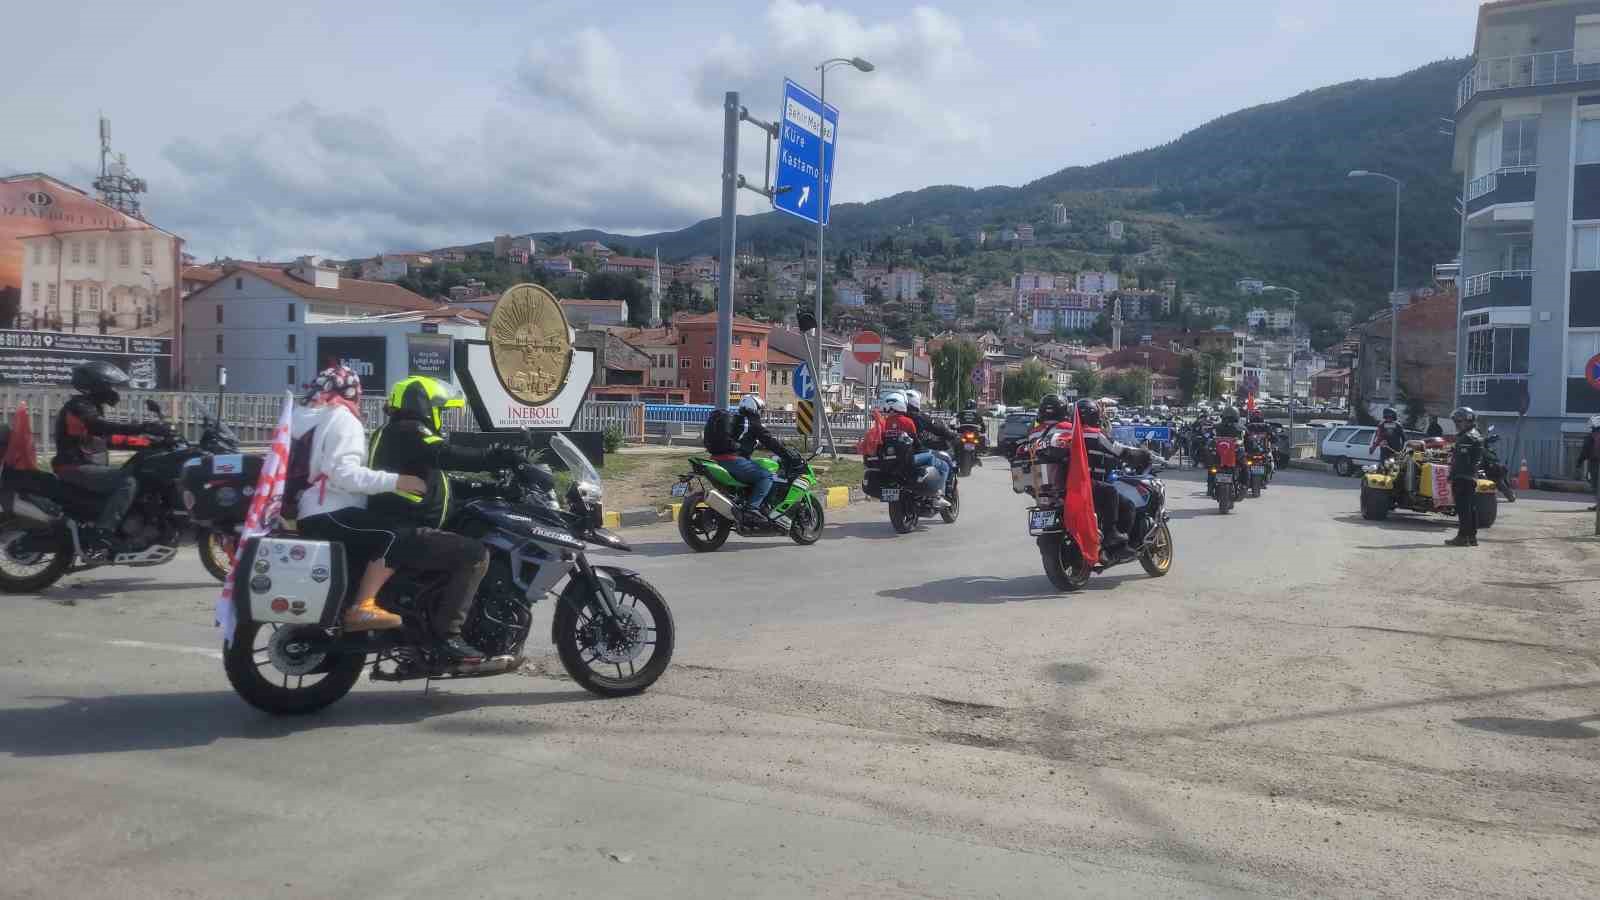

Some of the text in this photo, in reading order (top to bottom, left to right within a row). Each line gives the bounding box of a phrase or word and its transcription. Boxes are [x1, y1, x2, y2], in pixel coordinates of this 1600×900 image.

[784, 126, 806, 148] Küre
[808, 115, 832, 138] Merezi
[782, 149, 829, 183] Kastamou
